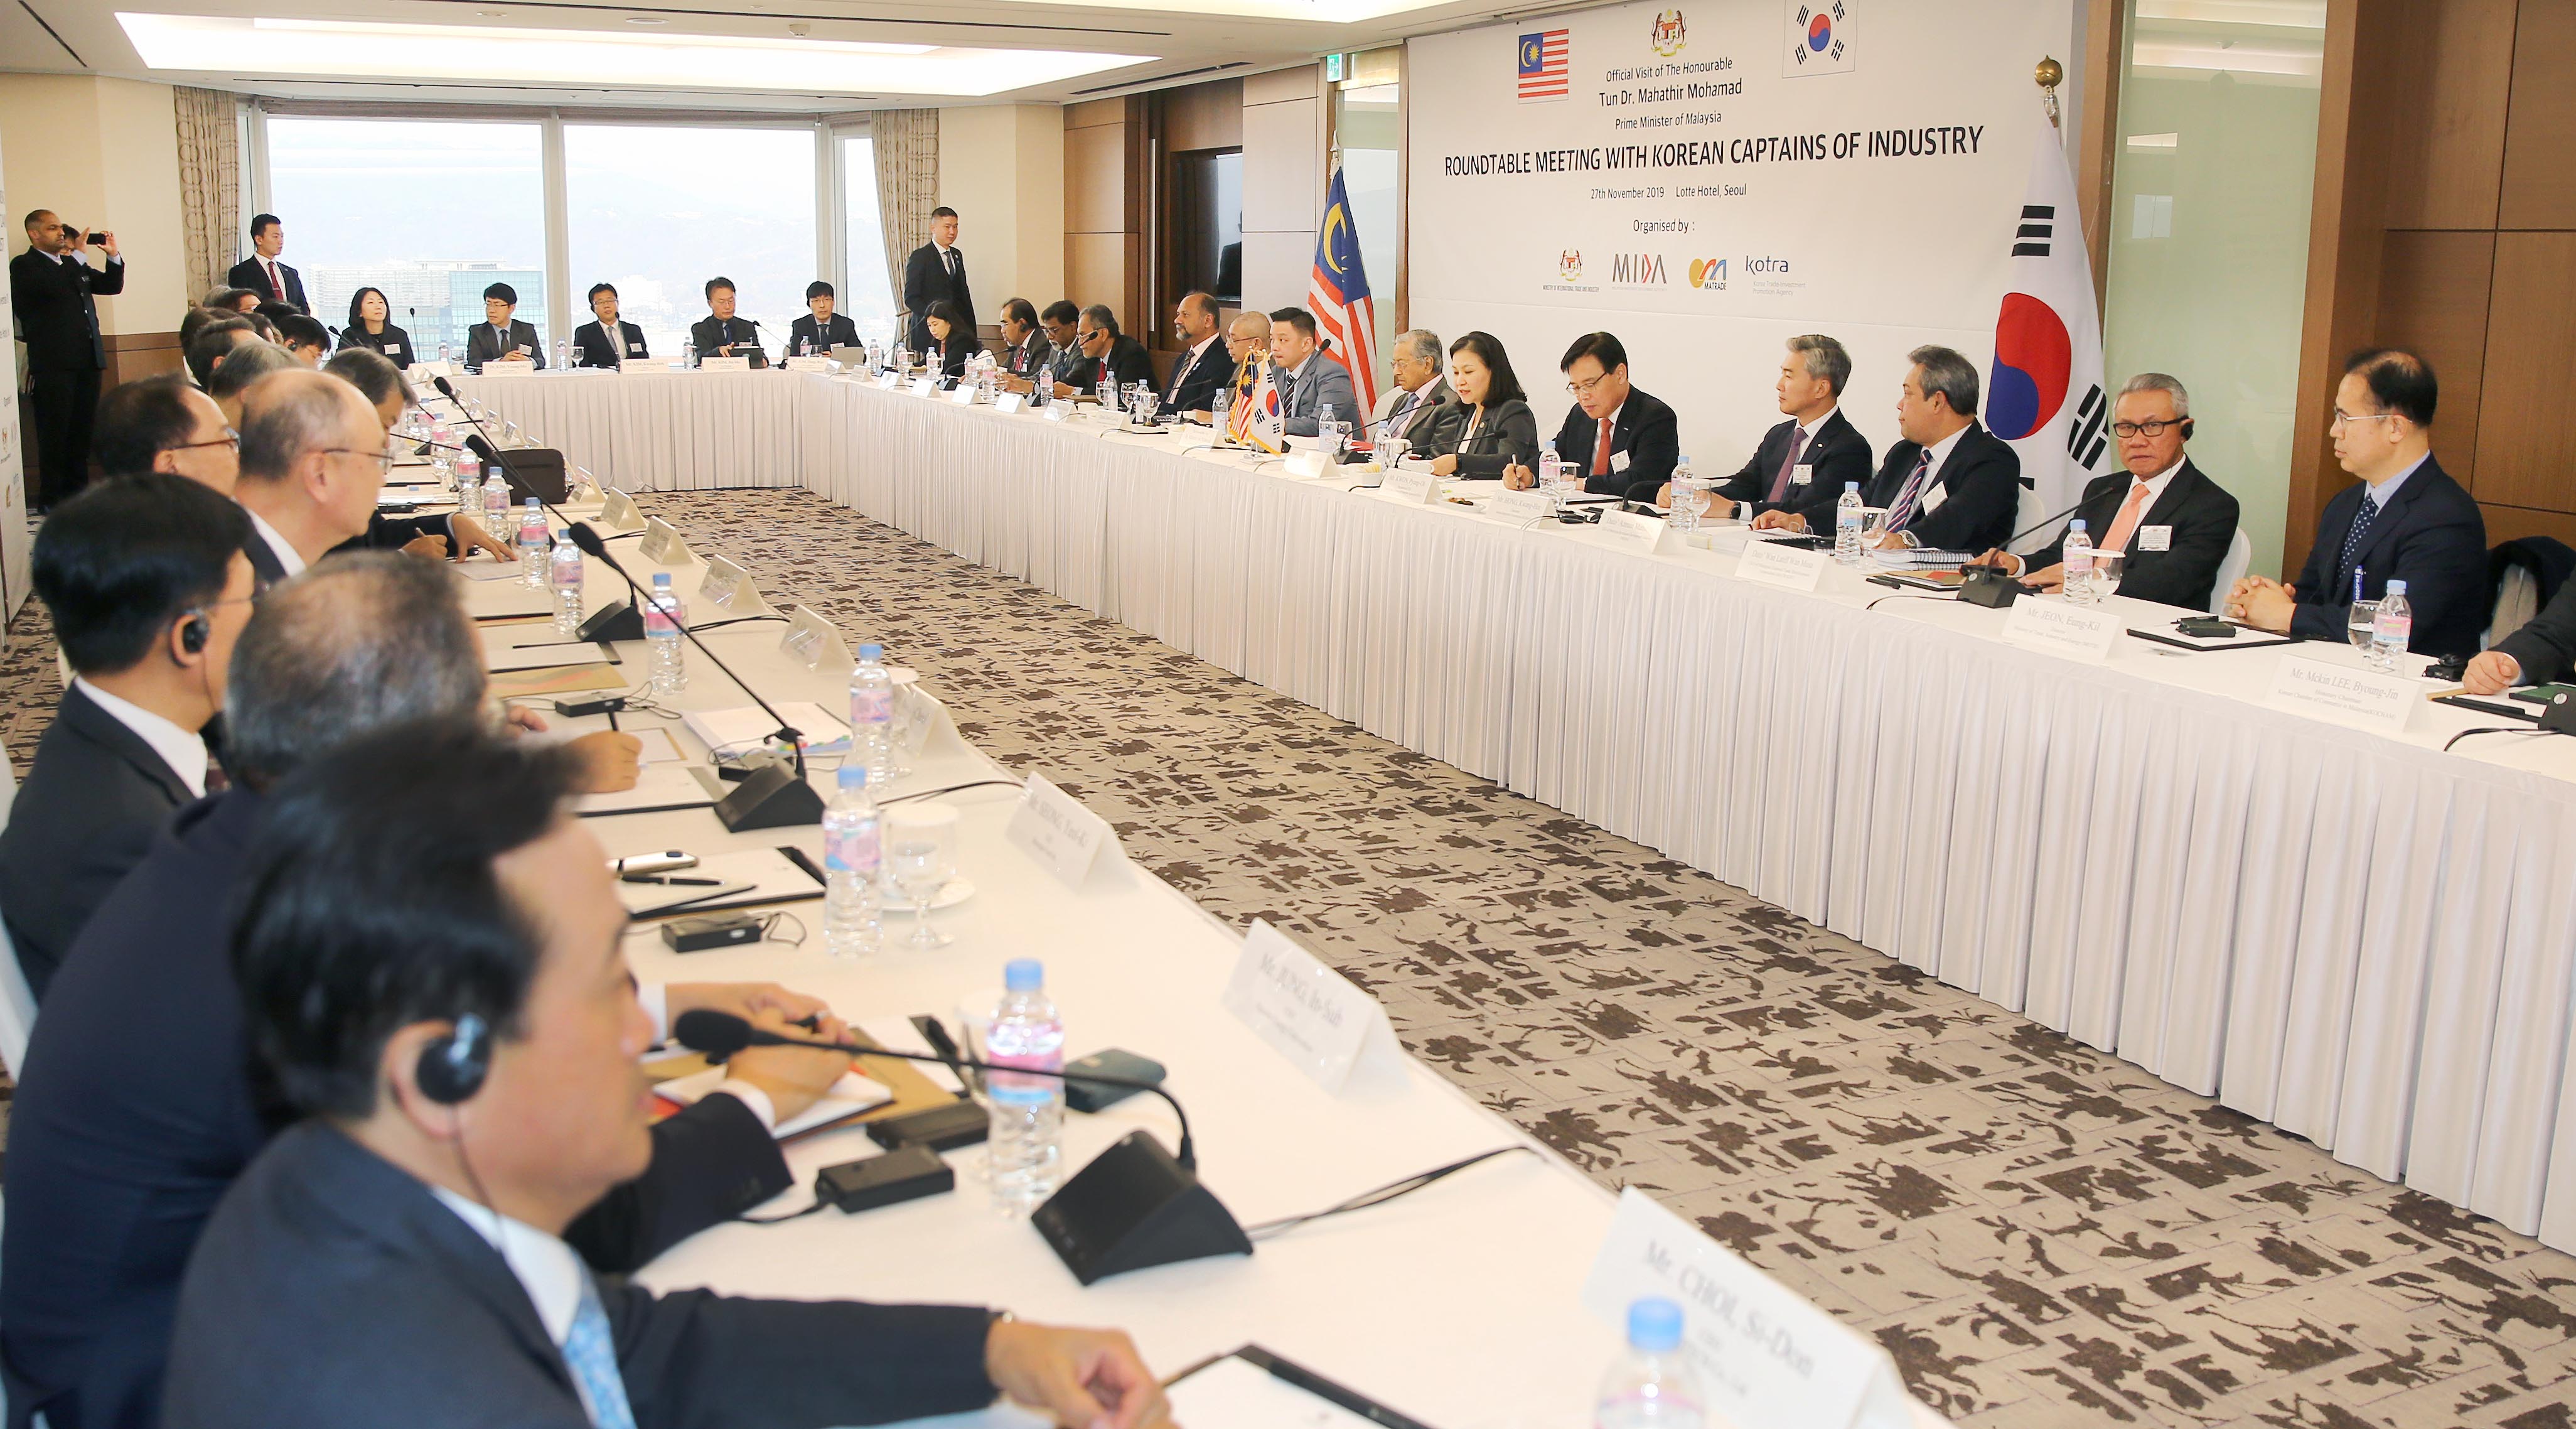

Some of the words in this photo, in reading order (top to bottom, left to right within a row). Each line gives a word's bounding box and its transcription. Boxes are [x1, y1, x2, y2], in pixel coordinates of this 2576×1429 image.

[1606, 67, 1633, 82] Official
[1636, 67, 1652, 79] Visit
[1655, 65, 1663, 77] of
[1666, 63, 1680, 76] The
[1683, 57, 1732, 74] Honourable
[1599, 92, 1618, 107] Tun
[1621, 90, 1634, 105] Dr.
[1638, 84, 1683, 104] Mahathir
[1688, 77, 1742, 99] Mohamad
[1615, 117, 1638, 130] Prime
[1640, 115, 1673, 128] Minister
[1675, 113, 1684, 126] of
[1685, 111, 1722, 126] Malaysia
[1445, 152, 1532, 176] ROUNDTABLE
[1535, 148, 1601, 173] MEETING
[1606, 145, 1647, 170] WITH
[1652, 141, 1724, 168] KOREAN
[1731, 134, 1827, 164] CAPTAINS
[1833, 132, 1861, 159] OF
[1868, 126, 1983, 157] INDUSTRY
[1591, 188, 1606, 199] 27th
[1607, 188, 1645, 199] November
[1646, 186, 1664, 198] 2019
[1676, 186, 1695, 197] Lotte
[1697, 185, 1722, 198] Hotel,
[1724, 183, 1746, 196] Seoul
[1633, 218, 1675, 234] Organised
[1678, 218, 1689, 234] by
[1612, 254, 1667, 284] MIDA
[1746, 255, 1788, 276] kotra
[1704, 282, 1727, 291] MATRADE
[2027, 607, 2039, 618] Mr.
[2290, 667, 2305, 679] Mr.
[2353, 681, 2399, 700] Byoung-Jin
[1642, 1237, 1674, 1282] Mr.
